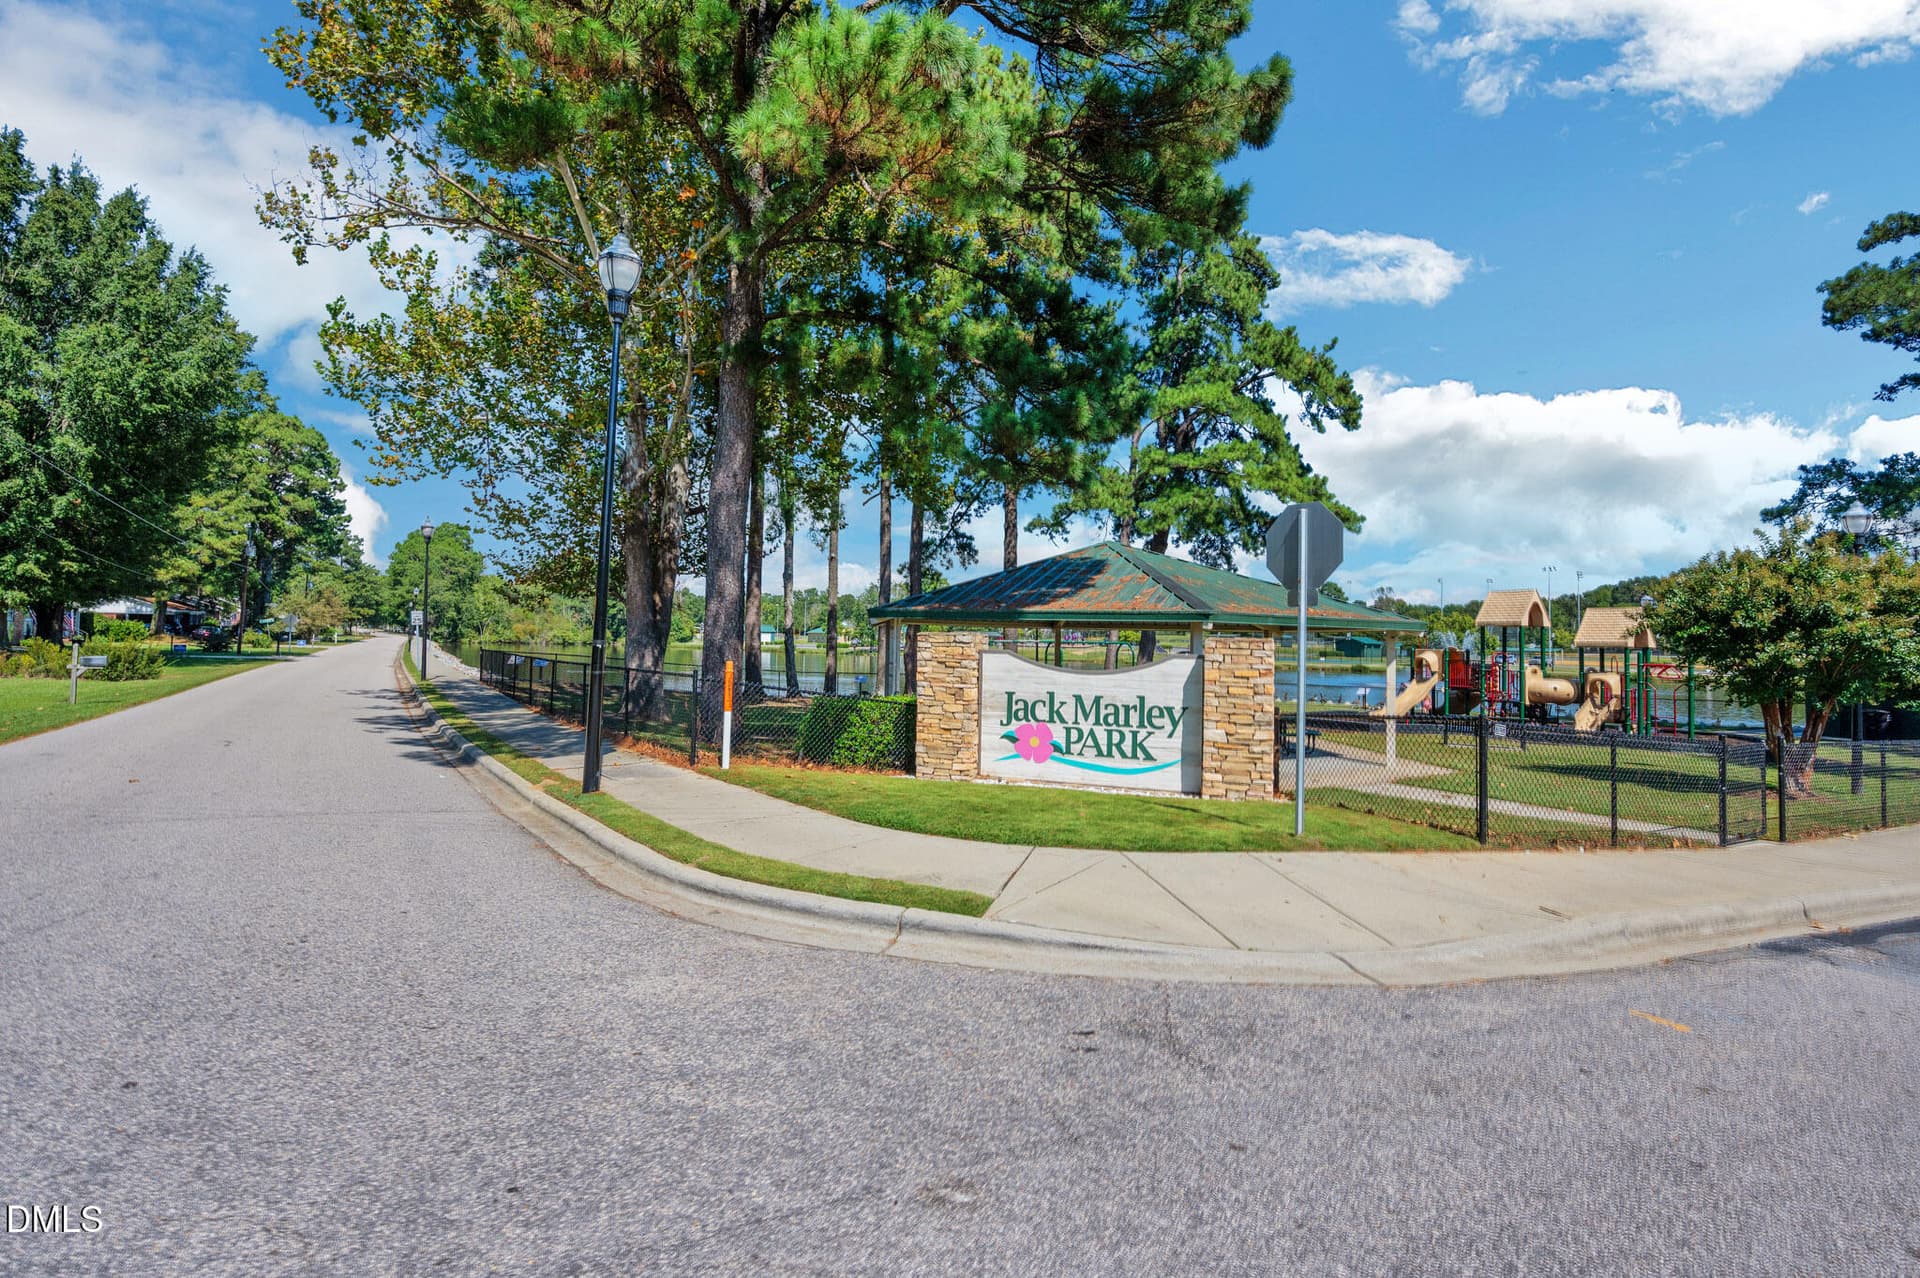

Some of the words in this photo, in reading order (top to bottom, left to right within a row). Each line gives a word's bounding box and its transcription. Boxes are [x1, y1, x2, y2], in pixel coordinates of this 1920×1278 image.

[1000, 691, 1068, 726] Jack
[1072, 694, 1189, 738] Marley
[1063, 726, 1157, 761] PARK
